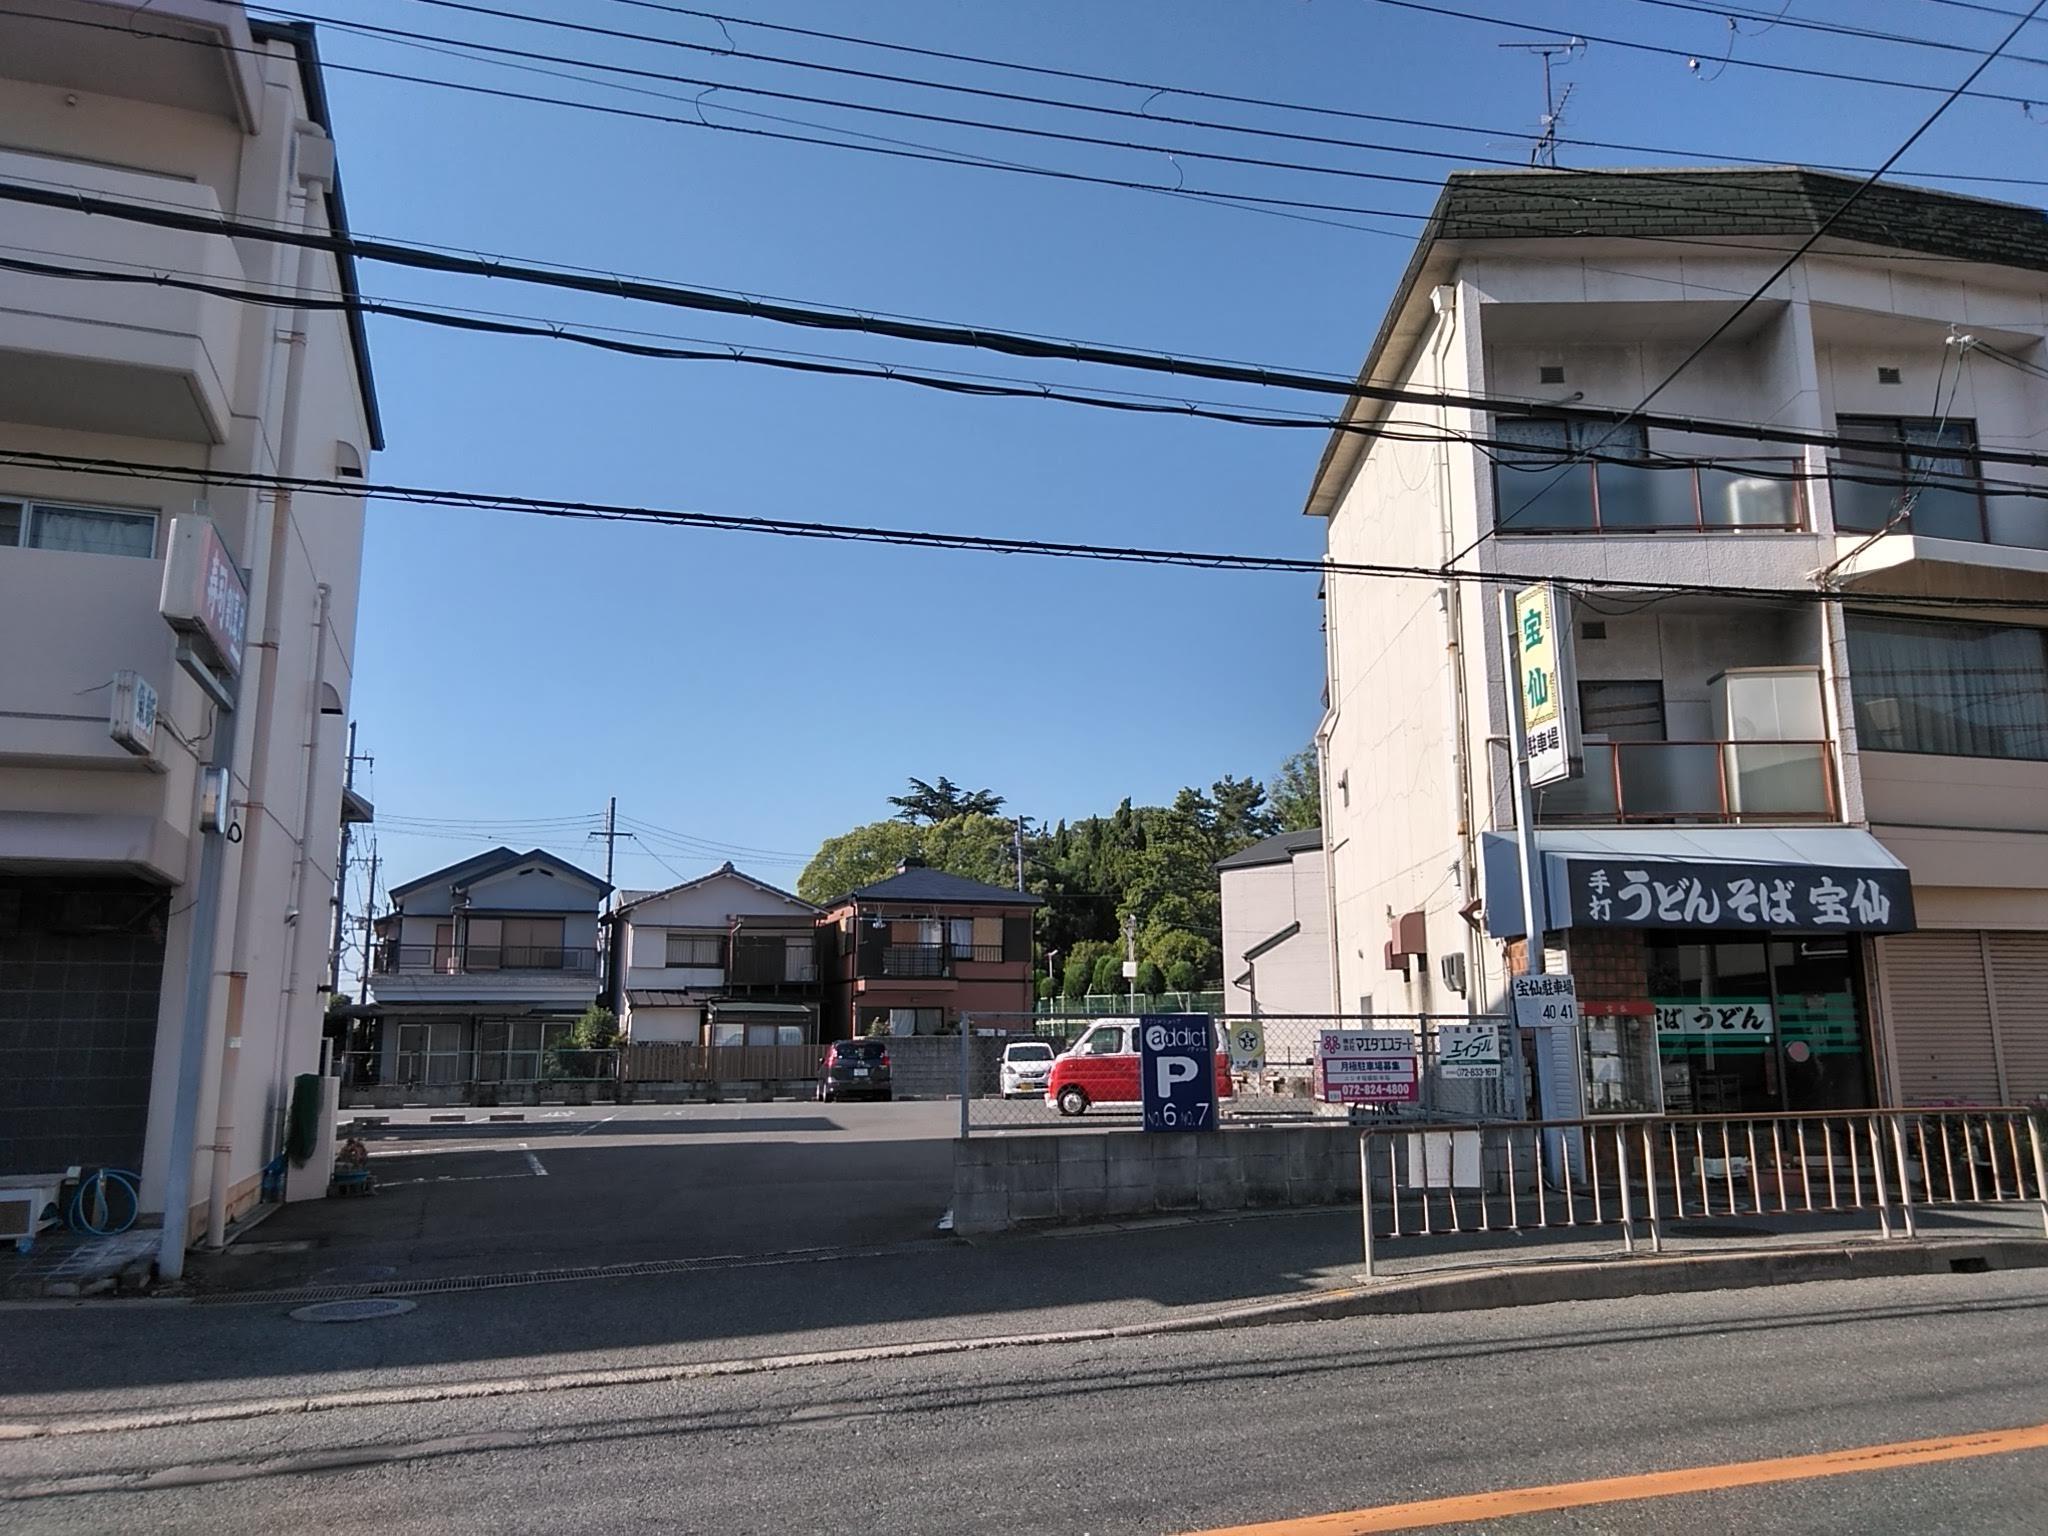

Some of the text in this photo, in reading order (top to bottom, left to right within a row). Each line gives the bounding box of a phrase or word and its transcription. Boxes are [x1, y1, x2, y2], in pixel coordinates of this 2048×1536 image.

[1523, 608, 1548, 710] 宝仙
[1528, 726, 1559, 759] 駐車場
[1588, 869, 1611, 921] 手打
[1617, 870, 1890, 926] うどん そば 宝仙
[1516, 978, 1574, 997] 宝仙駐車場
[1543, 1004, 1573, 1019] 40 41
[1693, 1006, 1766, 1031] うどん
[1145, 1025, 1207, 1052] addict
[1446, 1034, 1494, 1058] エイブル
[1157, 1056, 1199, 1098] P
[1342, 1084, 1409, 1095] 072-824-4800
